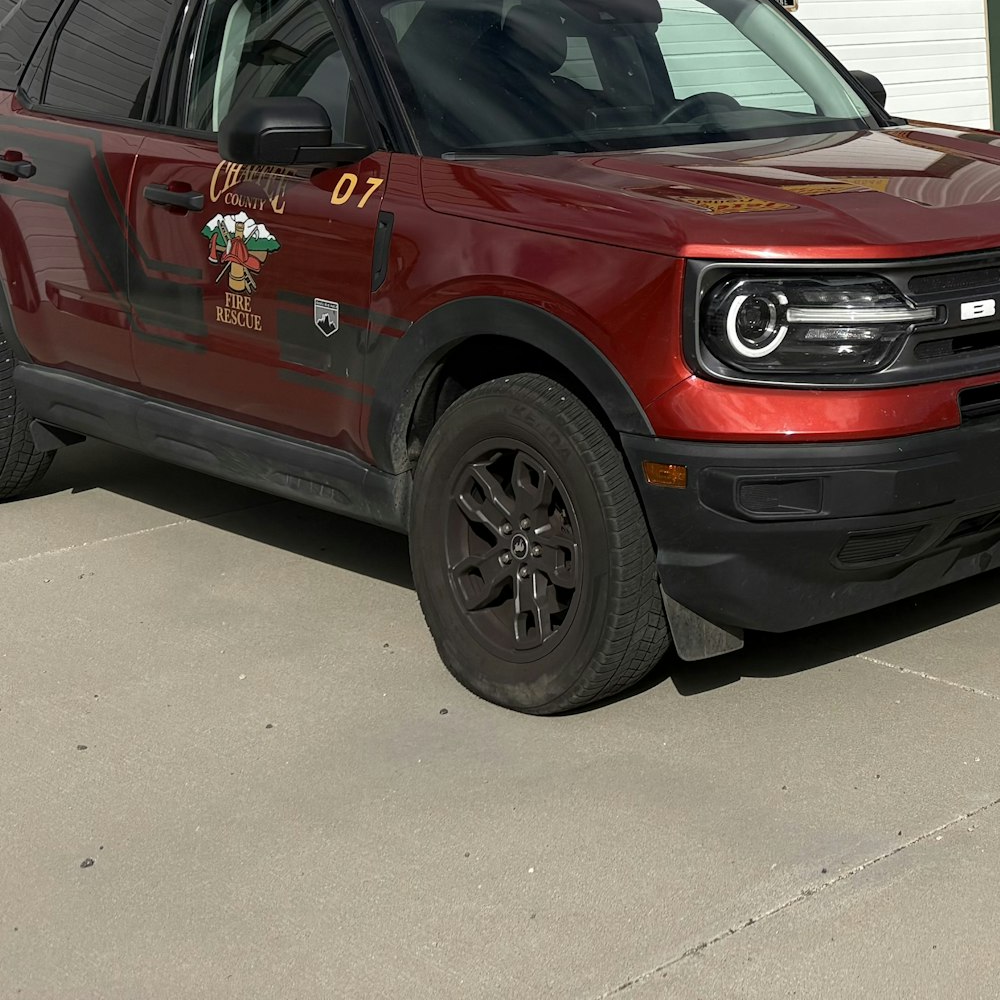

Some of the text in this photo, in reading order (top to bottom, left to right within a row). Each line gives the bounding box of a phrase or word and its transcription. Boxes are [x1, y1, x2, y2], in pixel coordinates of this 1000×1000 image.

[224, 192, 266, 211] COUNTY
[225, 292, 252, 313] FIRE
[215, 306, 262, 331] RESCUE
